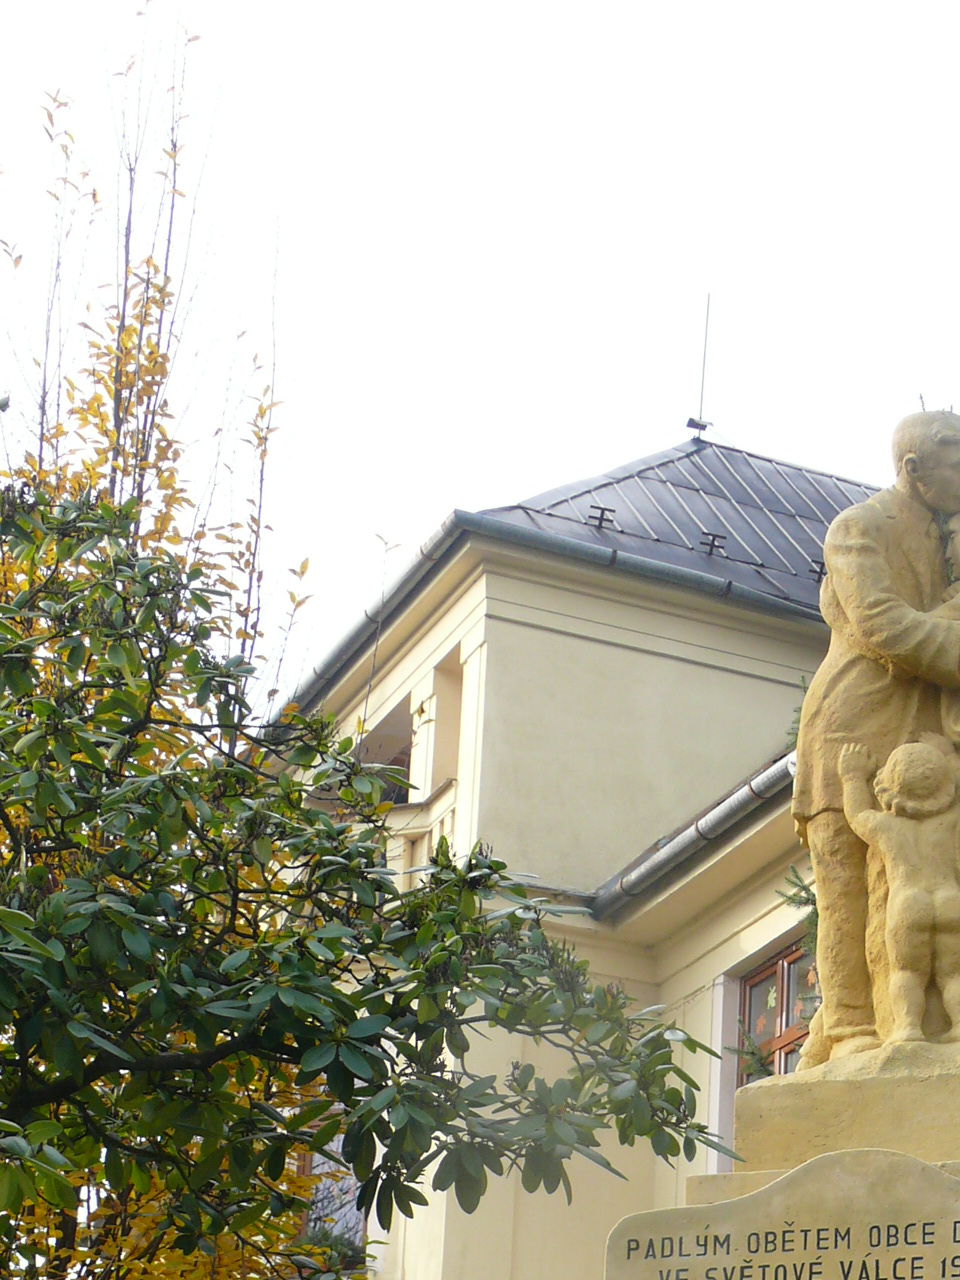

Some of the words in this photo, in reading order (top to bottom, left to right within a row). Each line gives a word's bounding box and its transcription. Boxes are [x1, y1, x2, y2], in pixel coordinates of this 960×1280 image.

[626, 1223, 731, 1260] PADLÝM
[747, 1220, 851, 1254] OBĚTEM
[869, 1222, 935, 1248] OBCE
